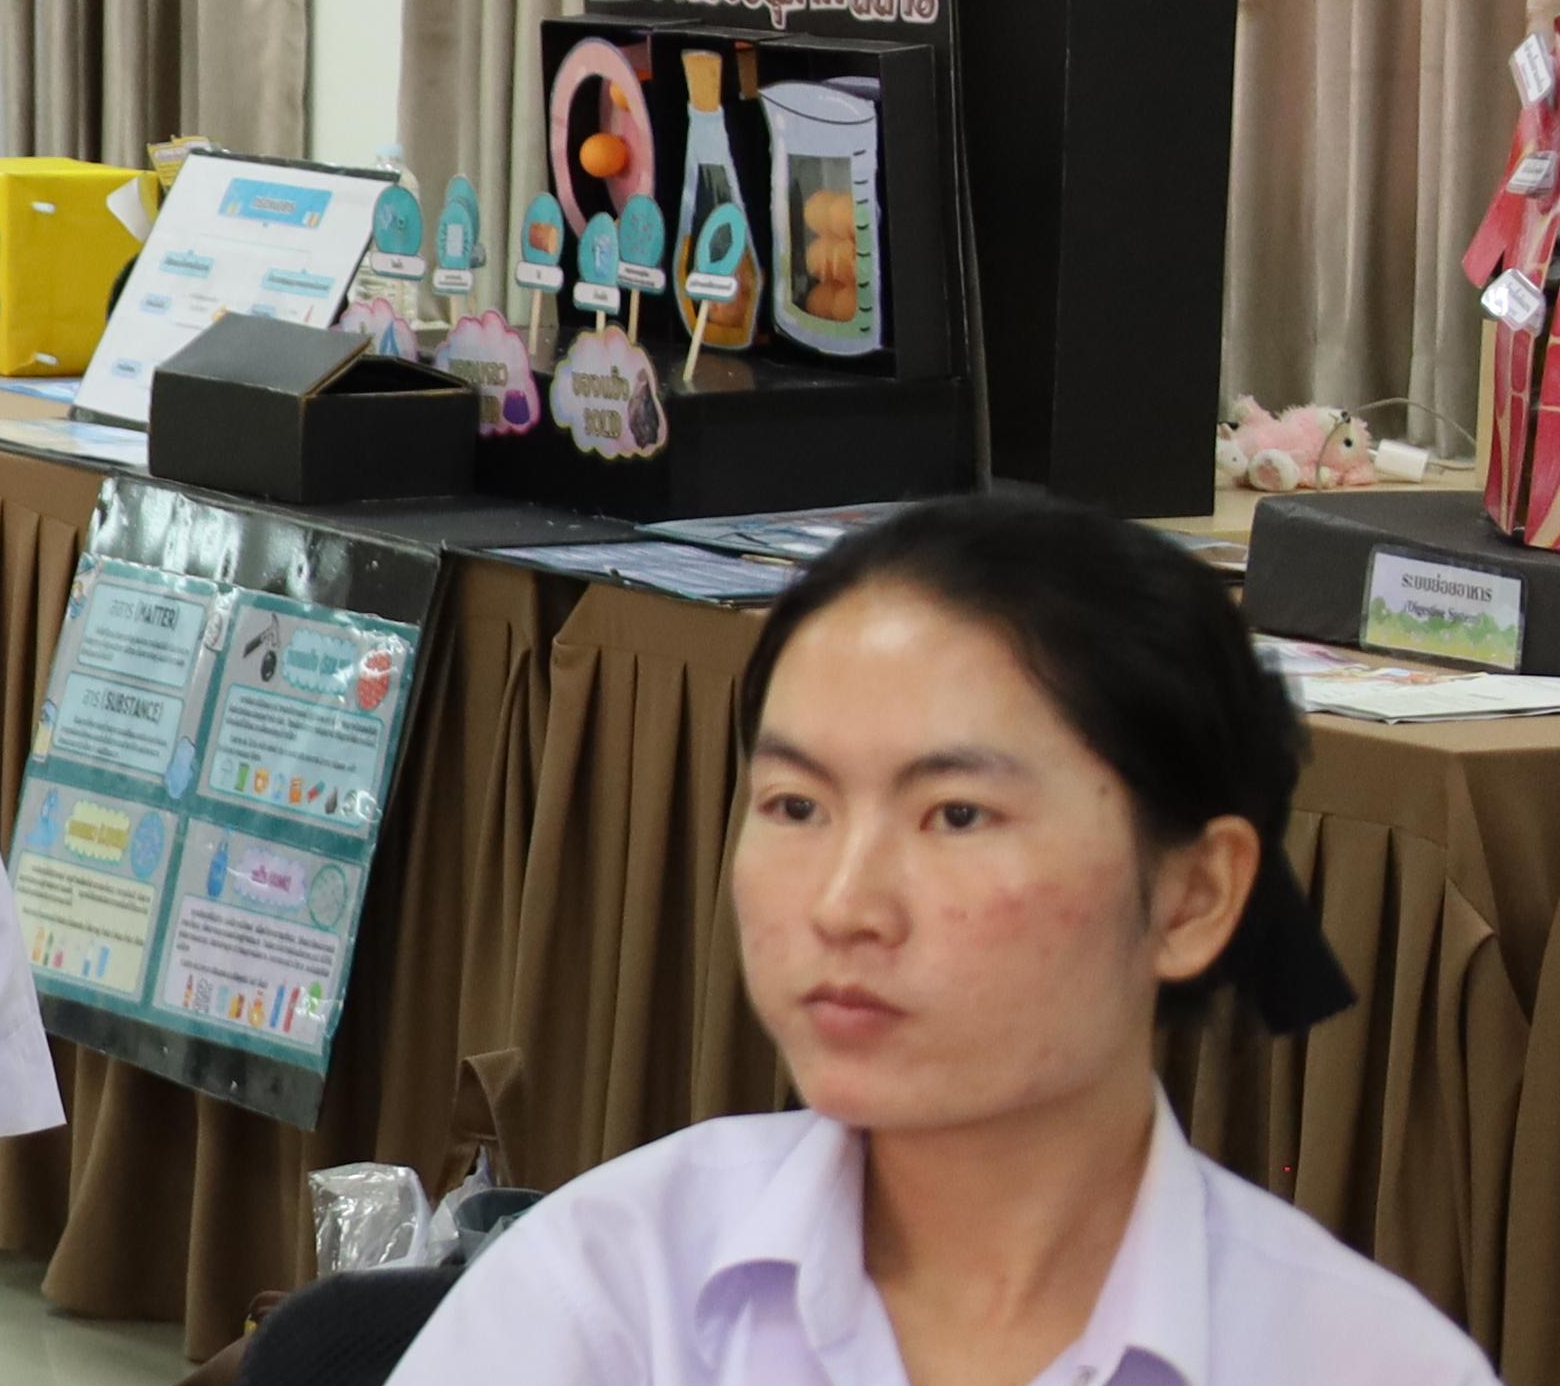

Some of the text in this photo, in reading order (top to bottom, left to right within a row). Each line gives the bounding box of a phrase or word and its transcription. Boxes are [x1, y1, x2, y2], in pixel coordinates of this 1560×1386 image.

[1401, 573, 1493, 603] ระบบย่อยอาหาร
